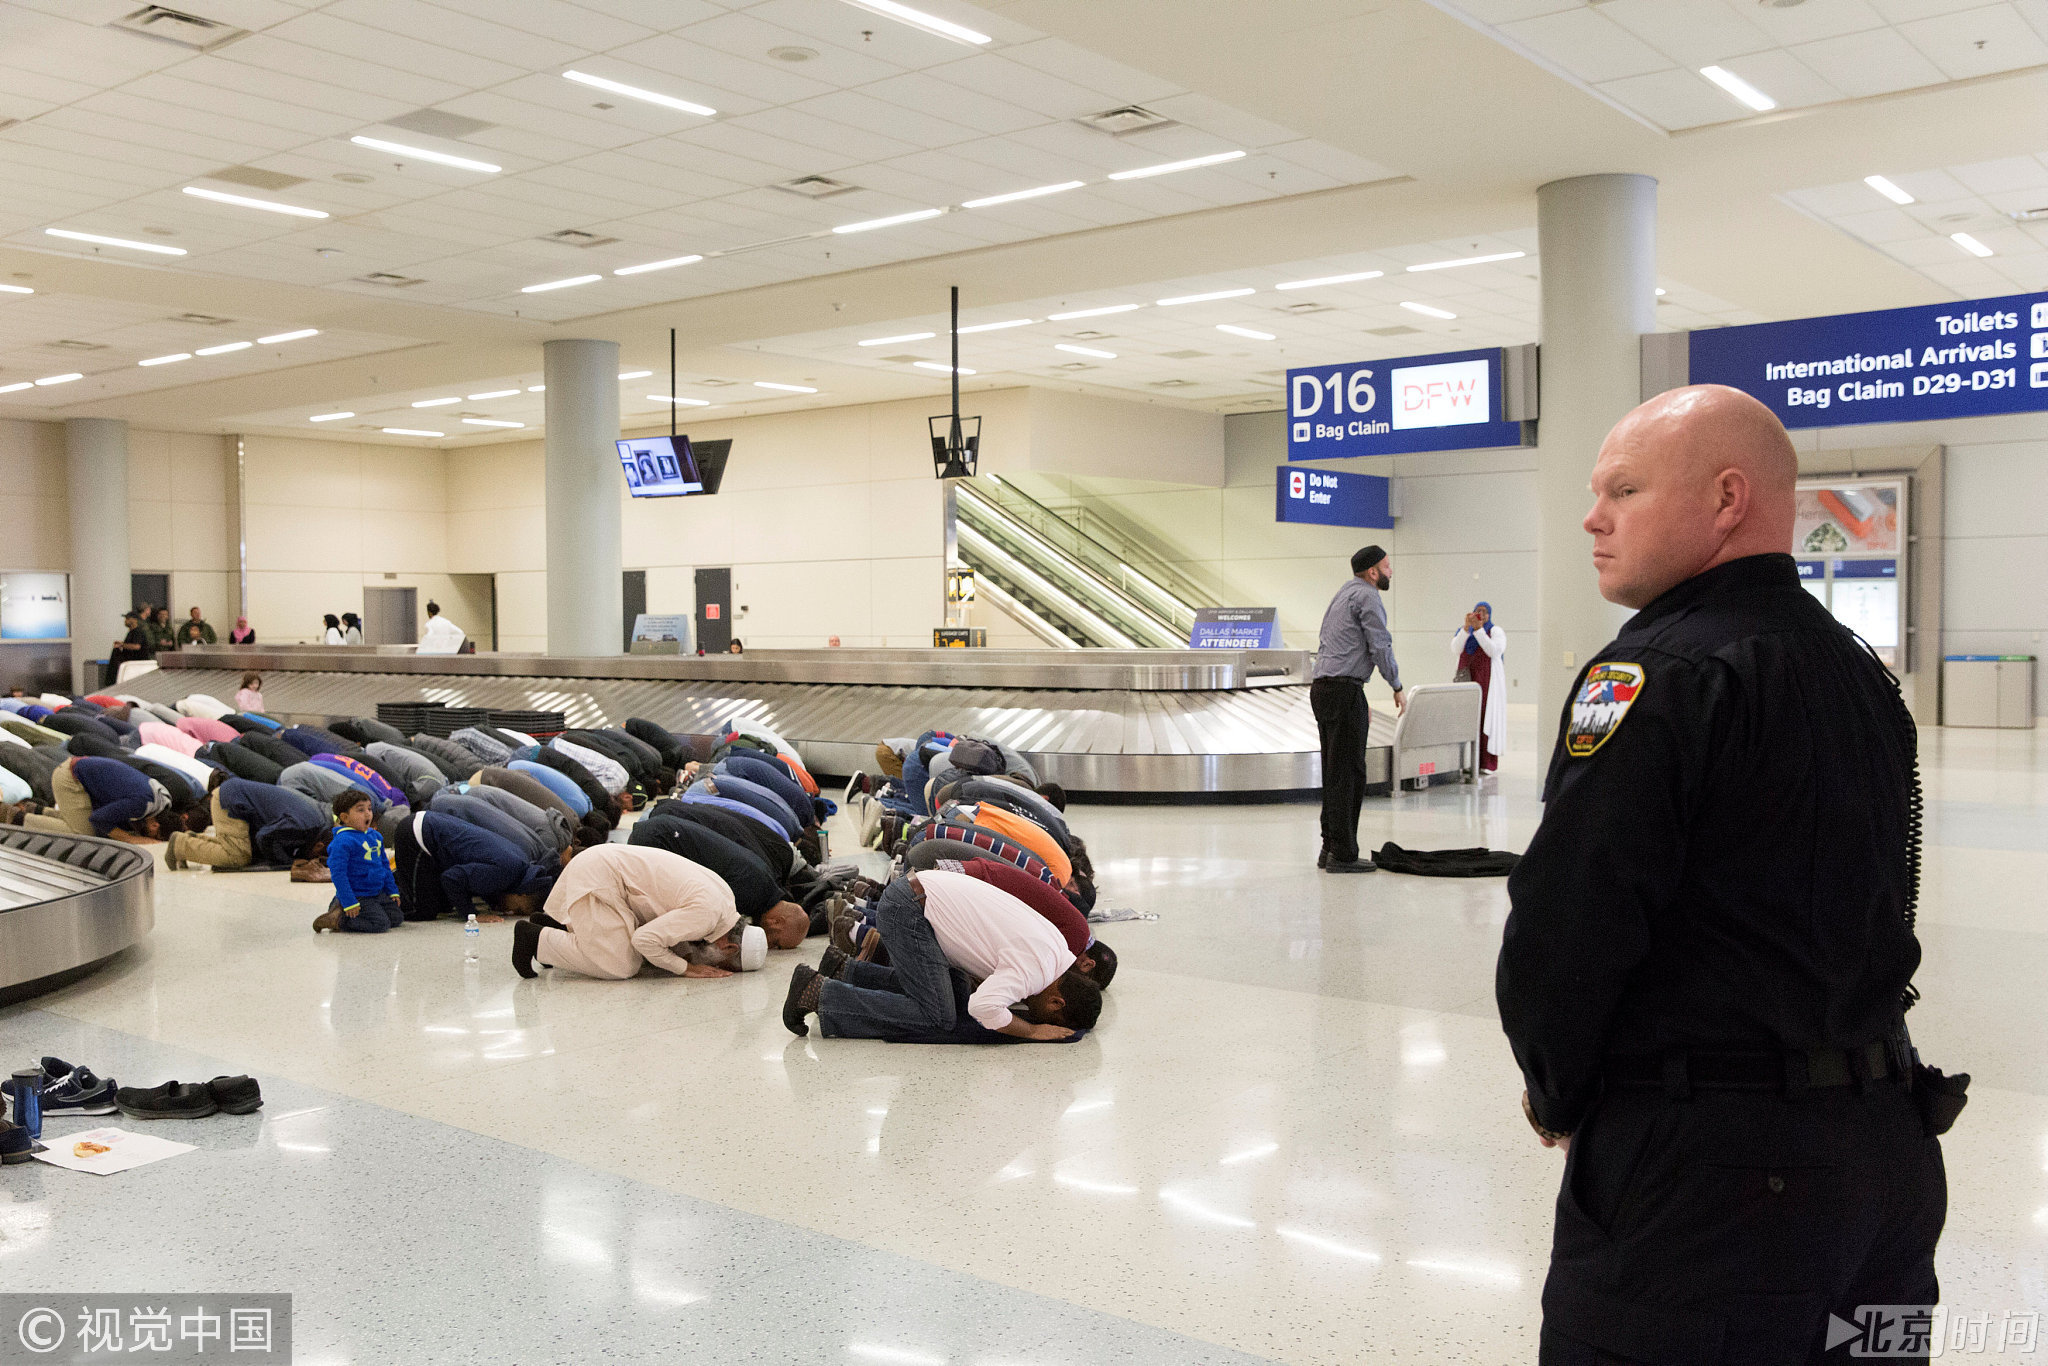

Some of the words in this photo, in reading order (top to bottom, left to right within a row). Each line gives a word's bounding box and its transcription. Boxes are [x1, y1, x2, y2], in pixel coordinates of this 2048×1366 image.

[1935, 311, 2019, 335] Toilets
[1765, 348, 1914, 381] International
[1919, 338, 2017, 367] Arrivals
[1292, 369, 1376, 418] D16
[1404, 379, 1475, 411] DFW
[1787, 387, 1831, 409] Bag
[1837, 379, 1905, 402] Claim
[1912, 367, 2017, 396] D29-D31
[1315, 424, 1344, 441] Bag
[1347, 420, 1390, 436] Claim
[1309, 473, 1322, 488] Do
[1322, 475, 1338, 489] Not
[1309, 490, 1331, 505] Enter
[1200, 628, 1229, 636] DALLAS
[1231, 628, 1264, 636] MARKET
[1200, 639, 1259, 647] ATTENDEES
